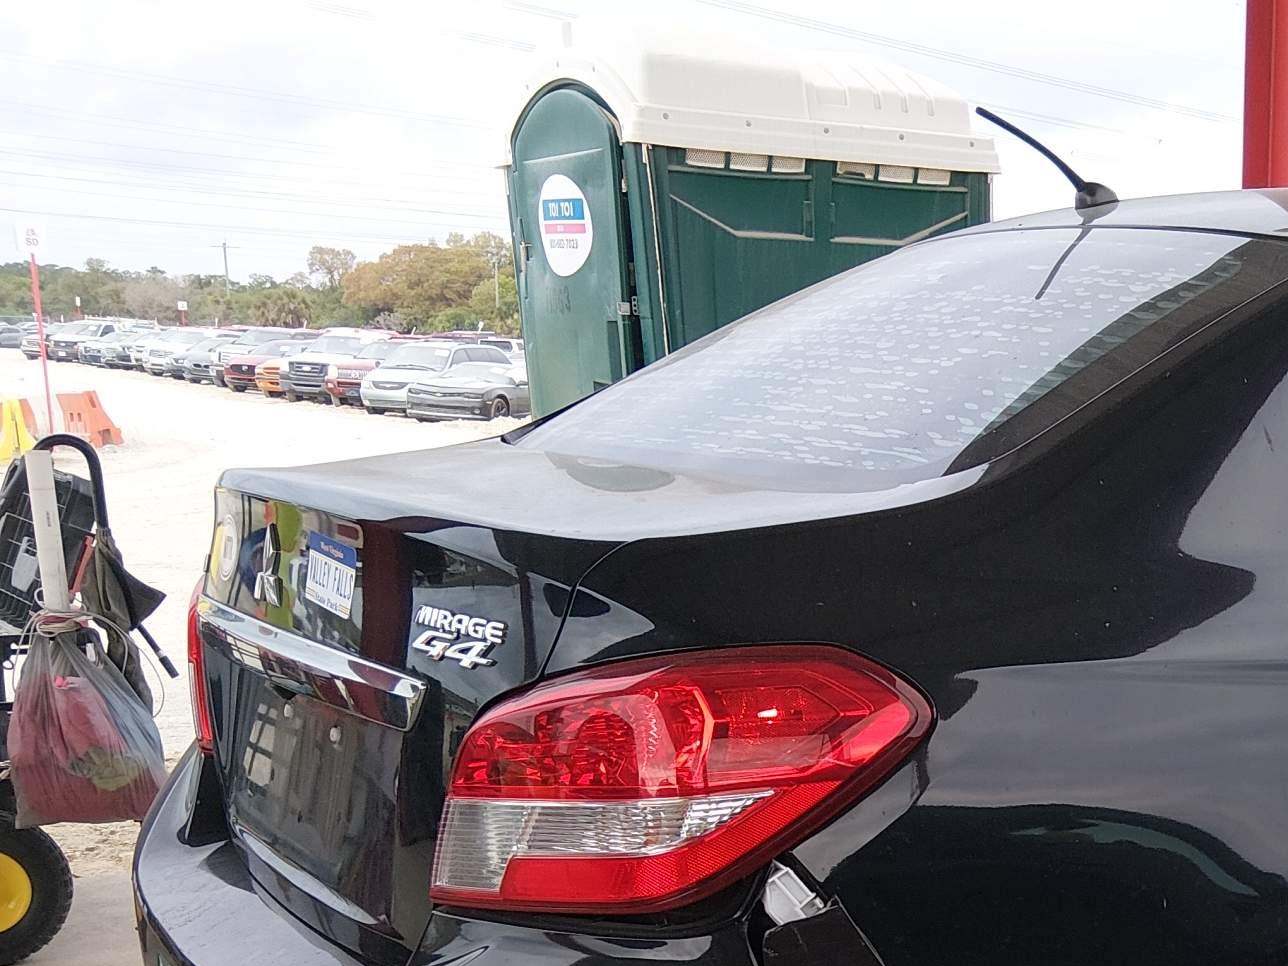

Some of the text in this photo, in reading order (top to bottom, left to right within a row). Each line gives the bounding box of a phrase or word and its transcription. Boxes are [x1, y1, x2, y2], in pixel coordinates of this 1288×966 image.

[548, 201, 574, 217] TOI TOI
[309, 553, 354, 601] VALLEY FALLS
[414, 604, 506, 645] MIRAGE
[411, 630, 497, 669] G4
